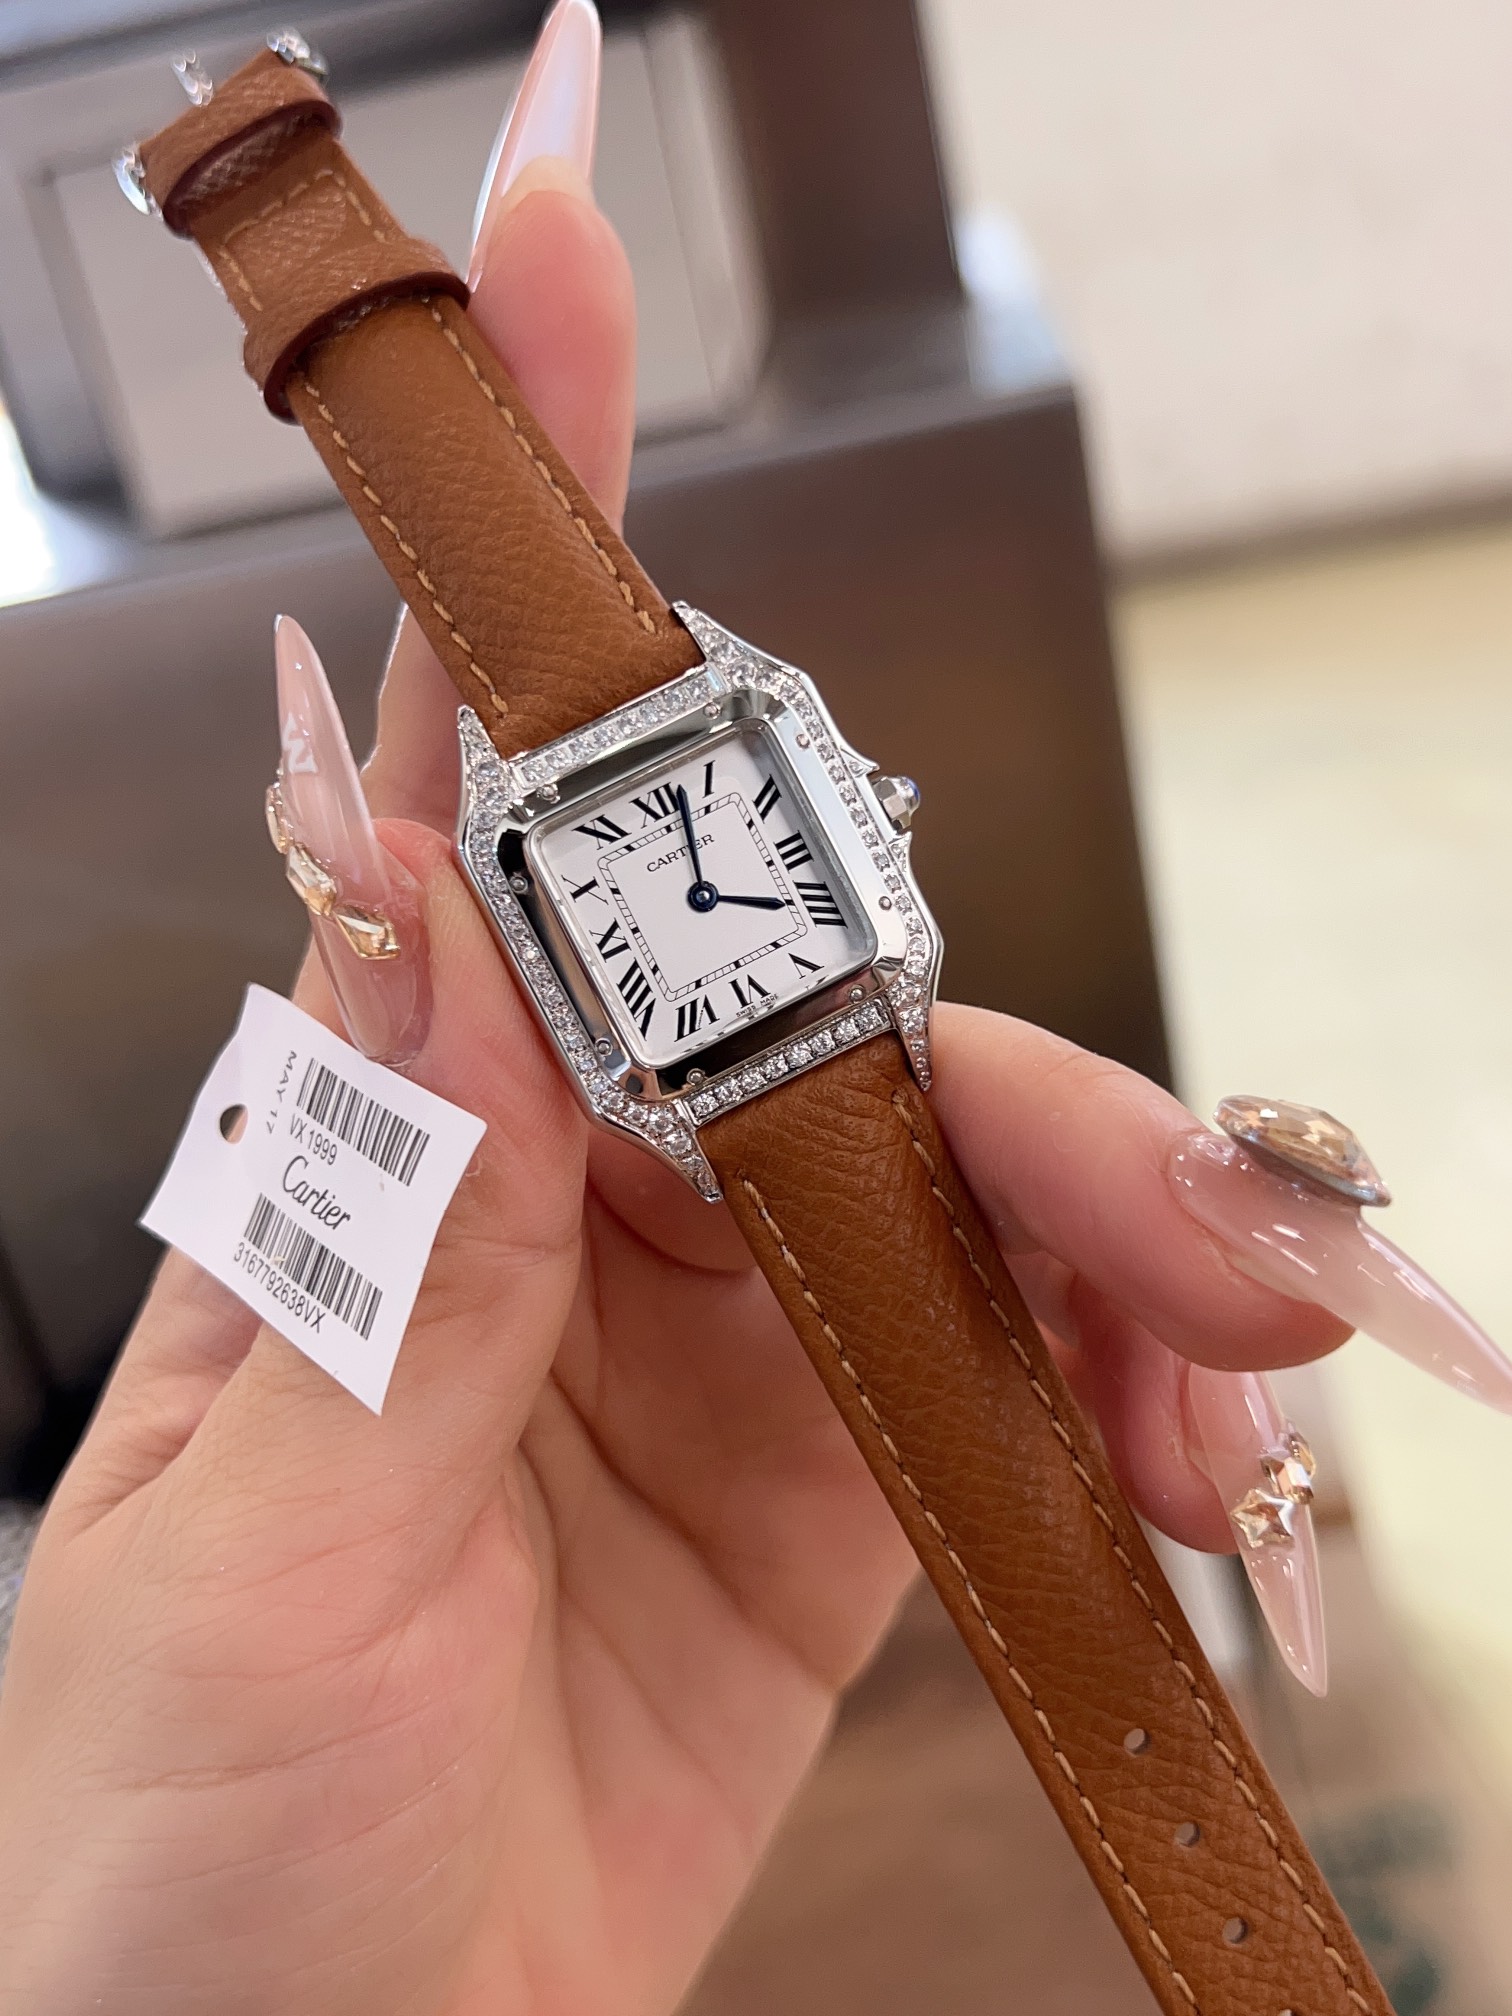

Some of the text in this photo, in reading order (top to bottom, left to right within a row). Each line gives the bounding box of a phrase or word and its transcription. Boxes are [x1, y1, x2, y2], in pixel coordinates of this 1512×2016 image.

[703, 760, 715, 798] I
[752, 774, 782, 824] II
[628, 782, 680, 829] XII
[571, 814, 632, 850] XI
[646, 834, 715, 872] CARTER
[773, 830, 814, 874] III
[561, 874, 609, 905] X
[792, 880, 848, 929] IIII
[588, 917, 632, 963] IX
[788, 952, 825, 980] V
[616, 957, 656, 1041] VIII
[728, 974, 772, 1008] VI
[674, 994, 720, 1043] VII
[276, 1050, 297, 1102] MAY
[282, 1155, 351, 1230] Cartier
[234, 1242, 326, 1333] 3167792638VX
